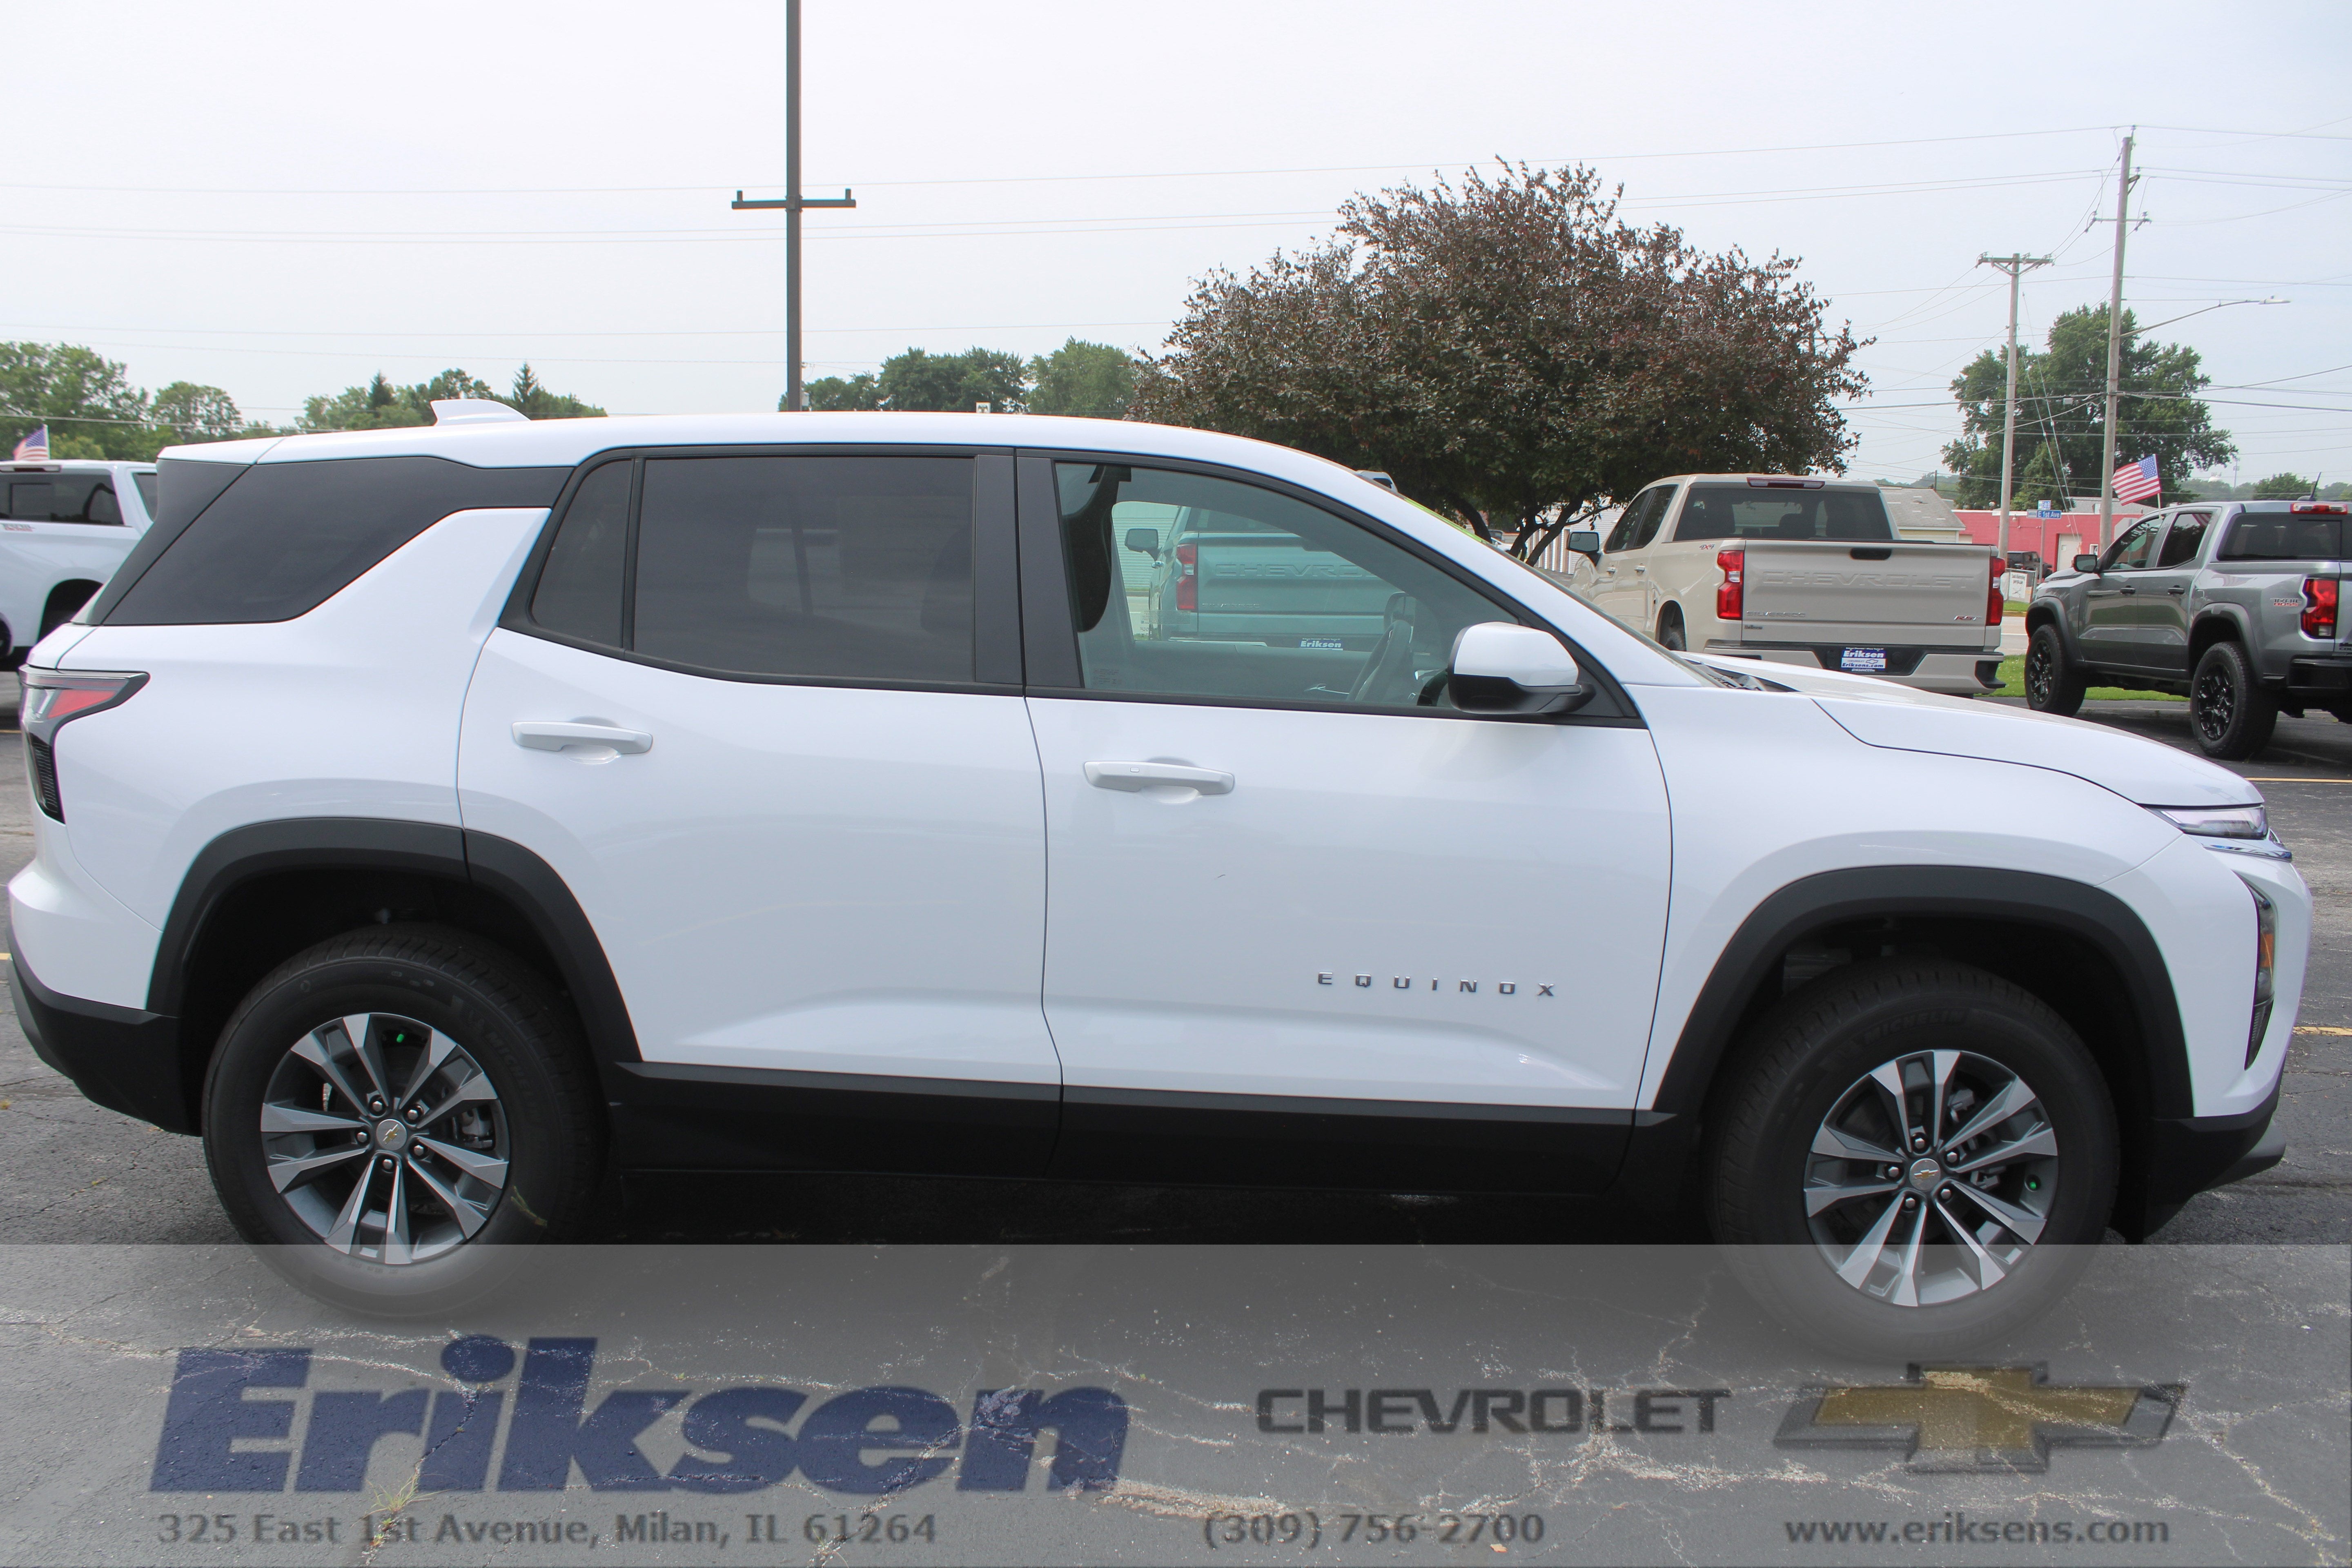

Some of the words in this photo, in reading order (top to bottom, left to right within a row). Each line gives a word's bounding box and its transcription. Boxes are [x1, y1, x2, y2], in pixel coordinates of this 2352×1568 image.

[1763, 572, 1974, 588] CHEVROLET
[1318, 971, 1555, 997] EQUINOX
[1864, 1011, 1965, 1044] MICHELIN
